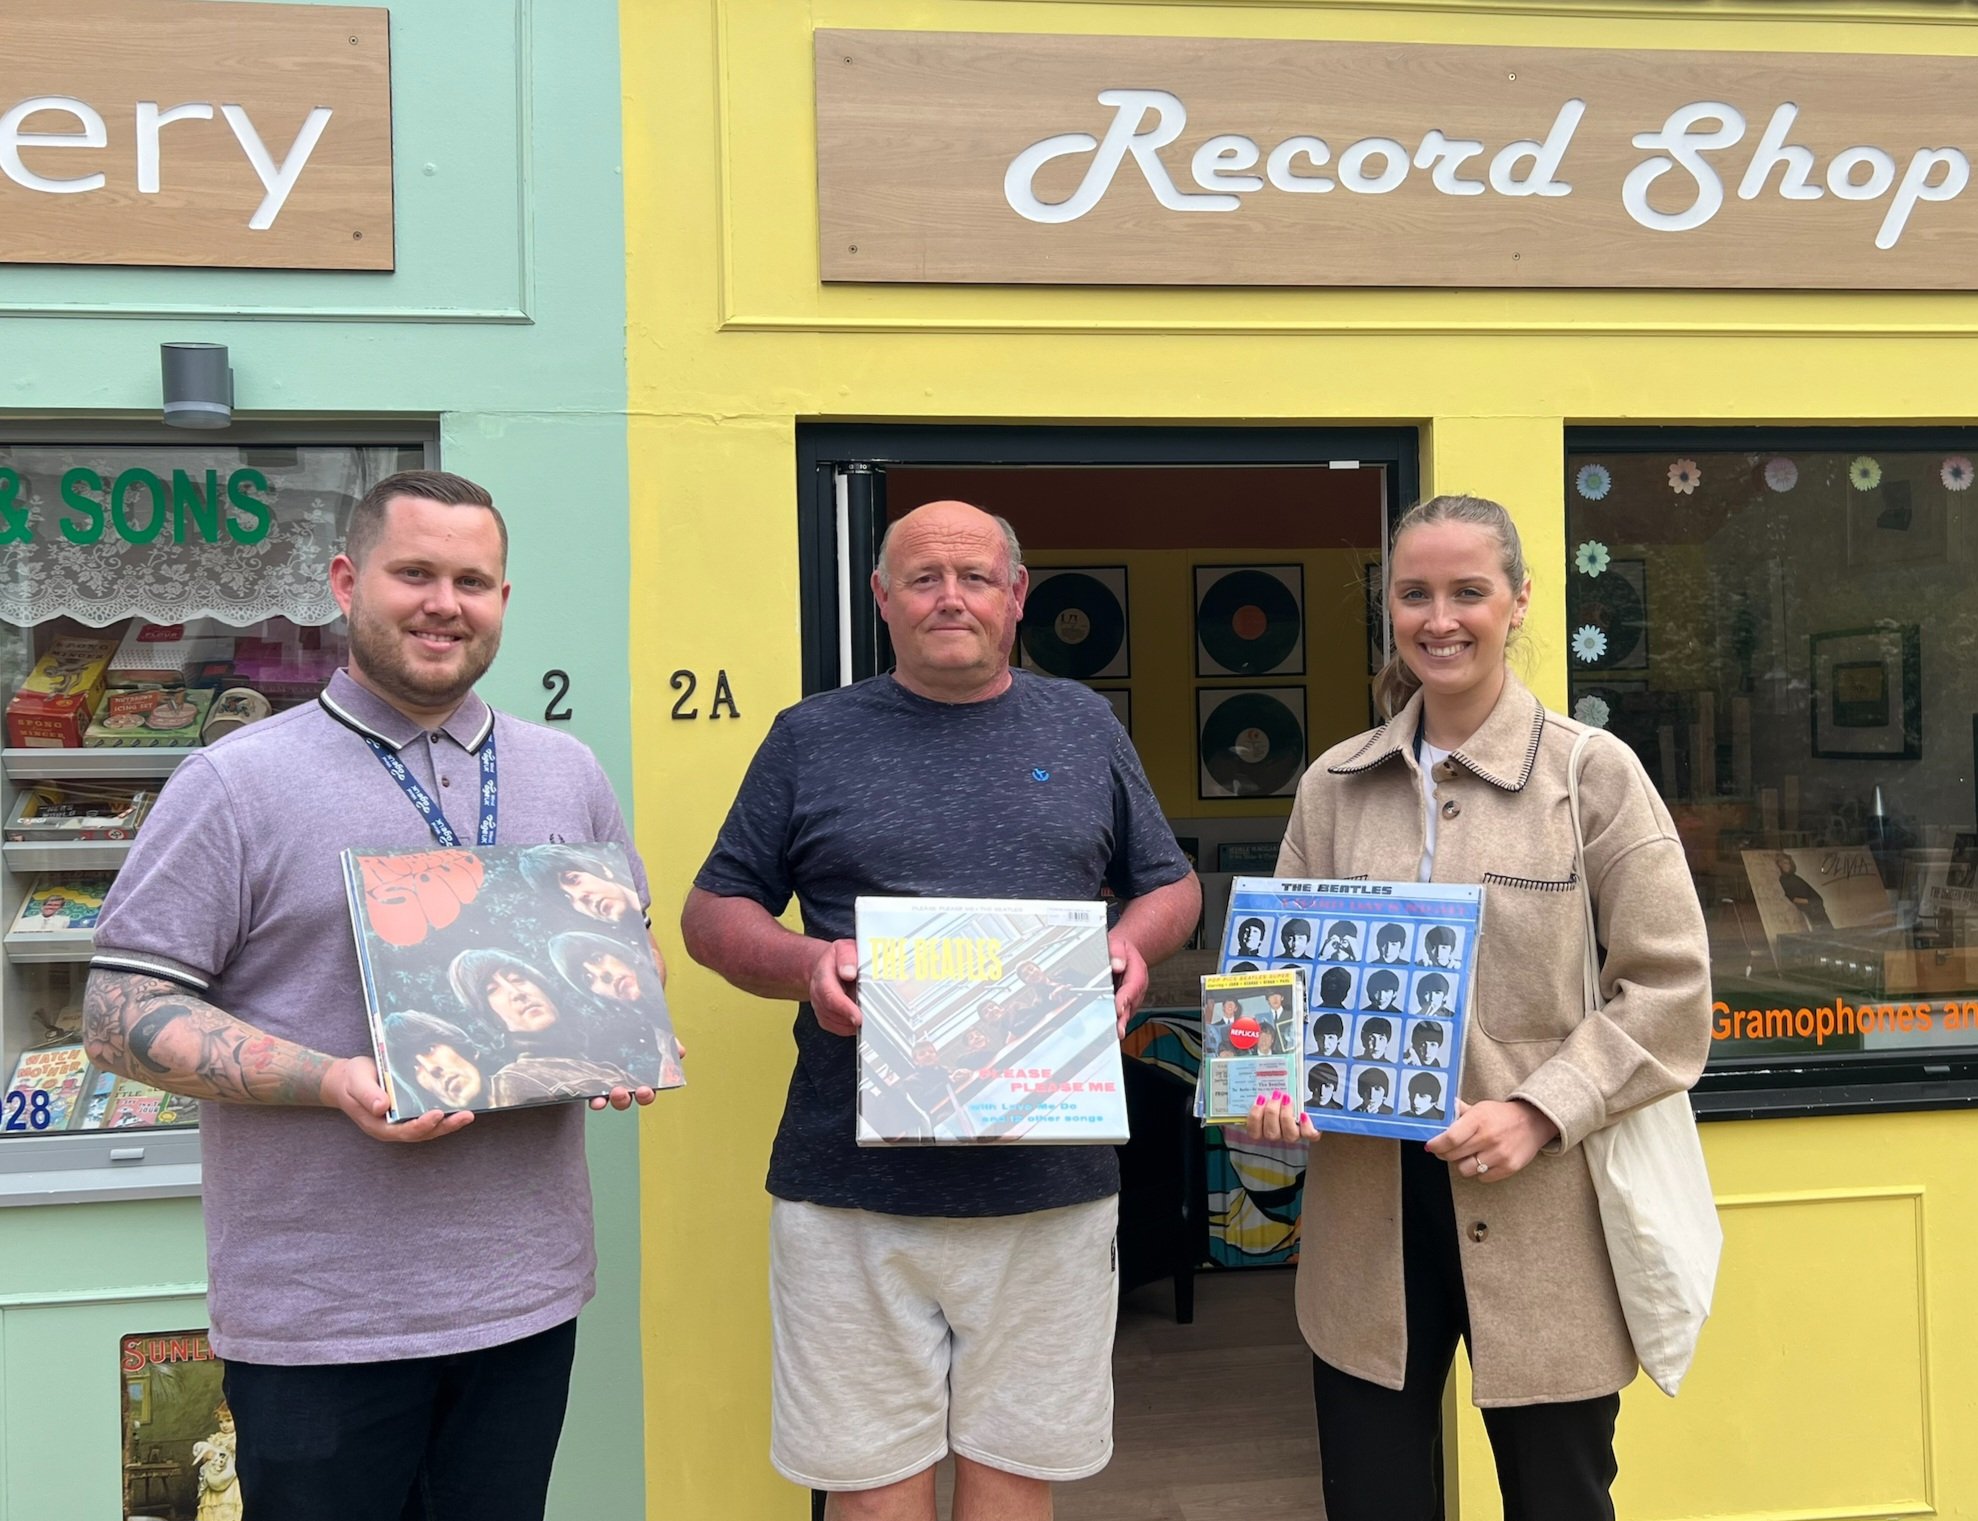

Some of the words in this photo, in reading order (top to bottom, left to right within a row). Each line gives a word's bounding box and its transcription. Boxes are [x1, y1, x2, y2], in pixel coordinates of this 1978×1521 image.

[0, 95, 333, 230] ery
[1004, 88, 1586, 223] Record
[1622, 100, 1970, 250] Shop
[60, 467, 270, 545] SONS
[542, 669, 573, 720] 2
[670, 669, 740, 719] 2A
[1281, 883, 1312, 893] THE
[1317, 884, 1393, 895] BEATLES
[869, 937, 908, 980] THE
[915, 937, 1003, 981] BEATLES
[1230, 1028, 1260, 1038] REPLICAS
[1711, 997, 1933, 1046] Gramophones
[17, 1061, 81, 1078] MOTHER
[978, 1068, 1052, 1079] PLEASE
[1011, 1082, 1084, 1093] PLEASE
[1088, 1082, 1116, 1093] ME
[0, 1090, 50, 1130] 28
[970, 1103, 997, 1111] with
[1064, 1115, 1104, 1124] songs
